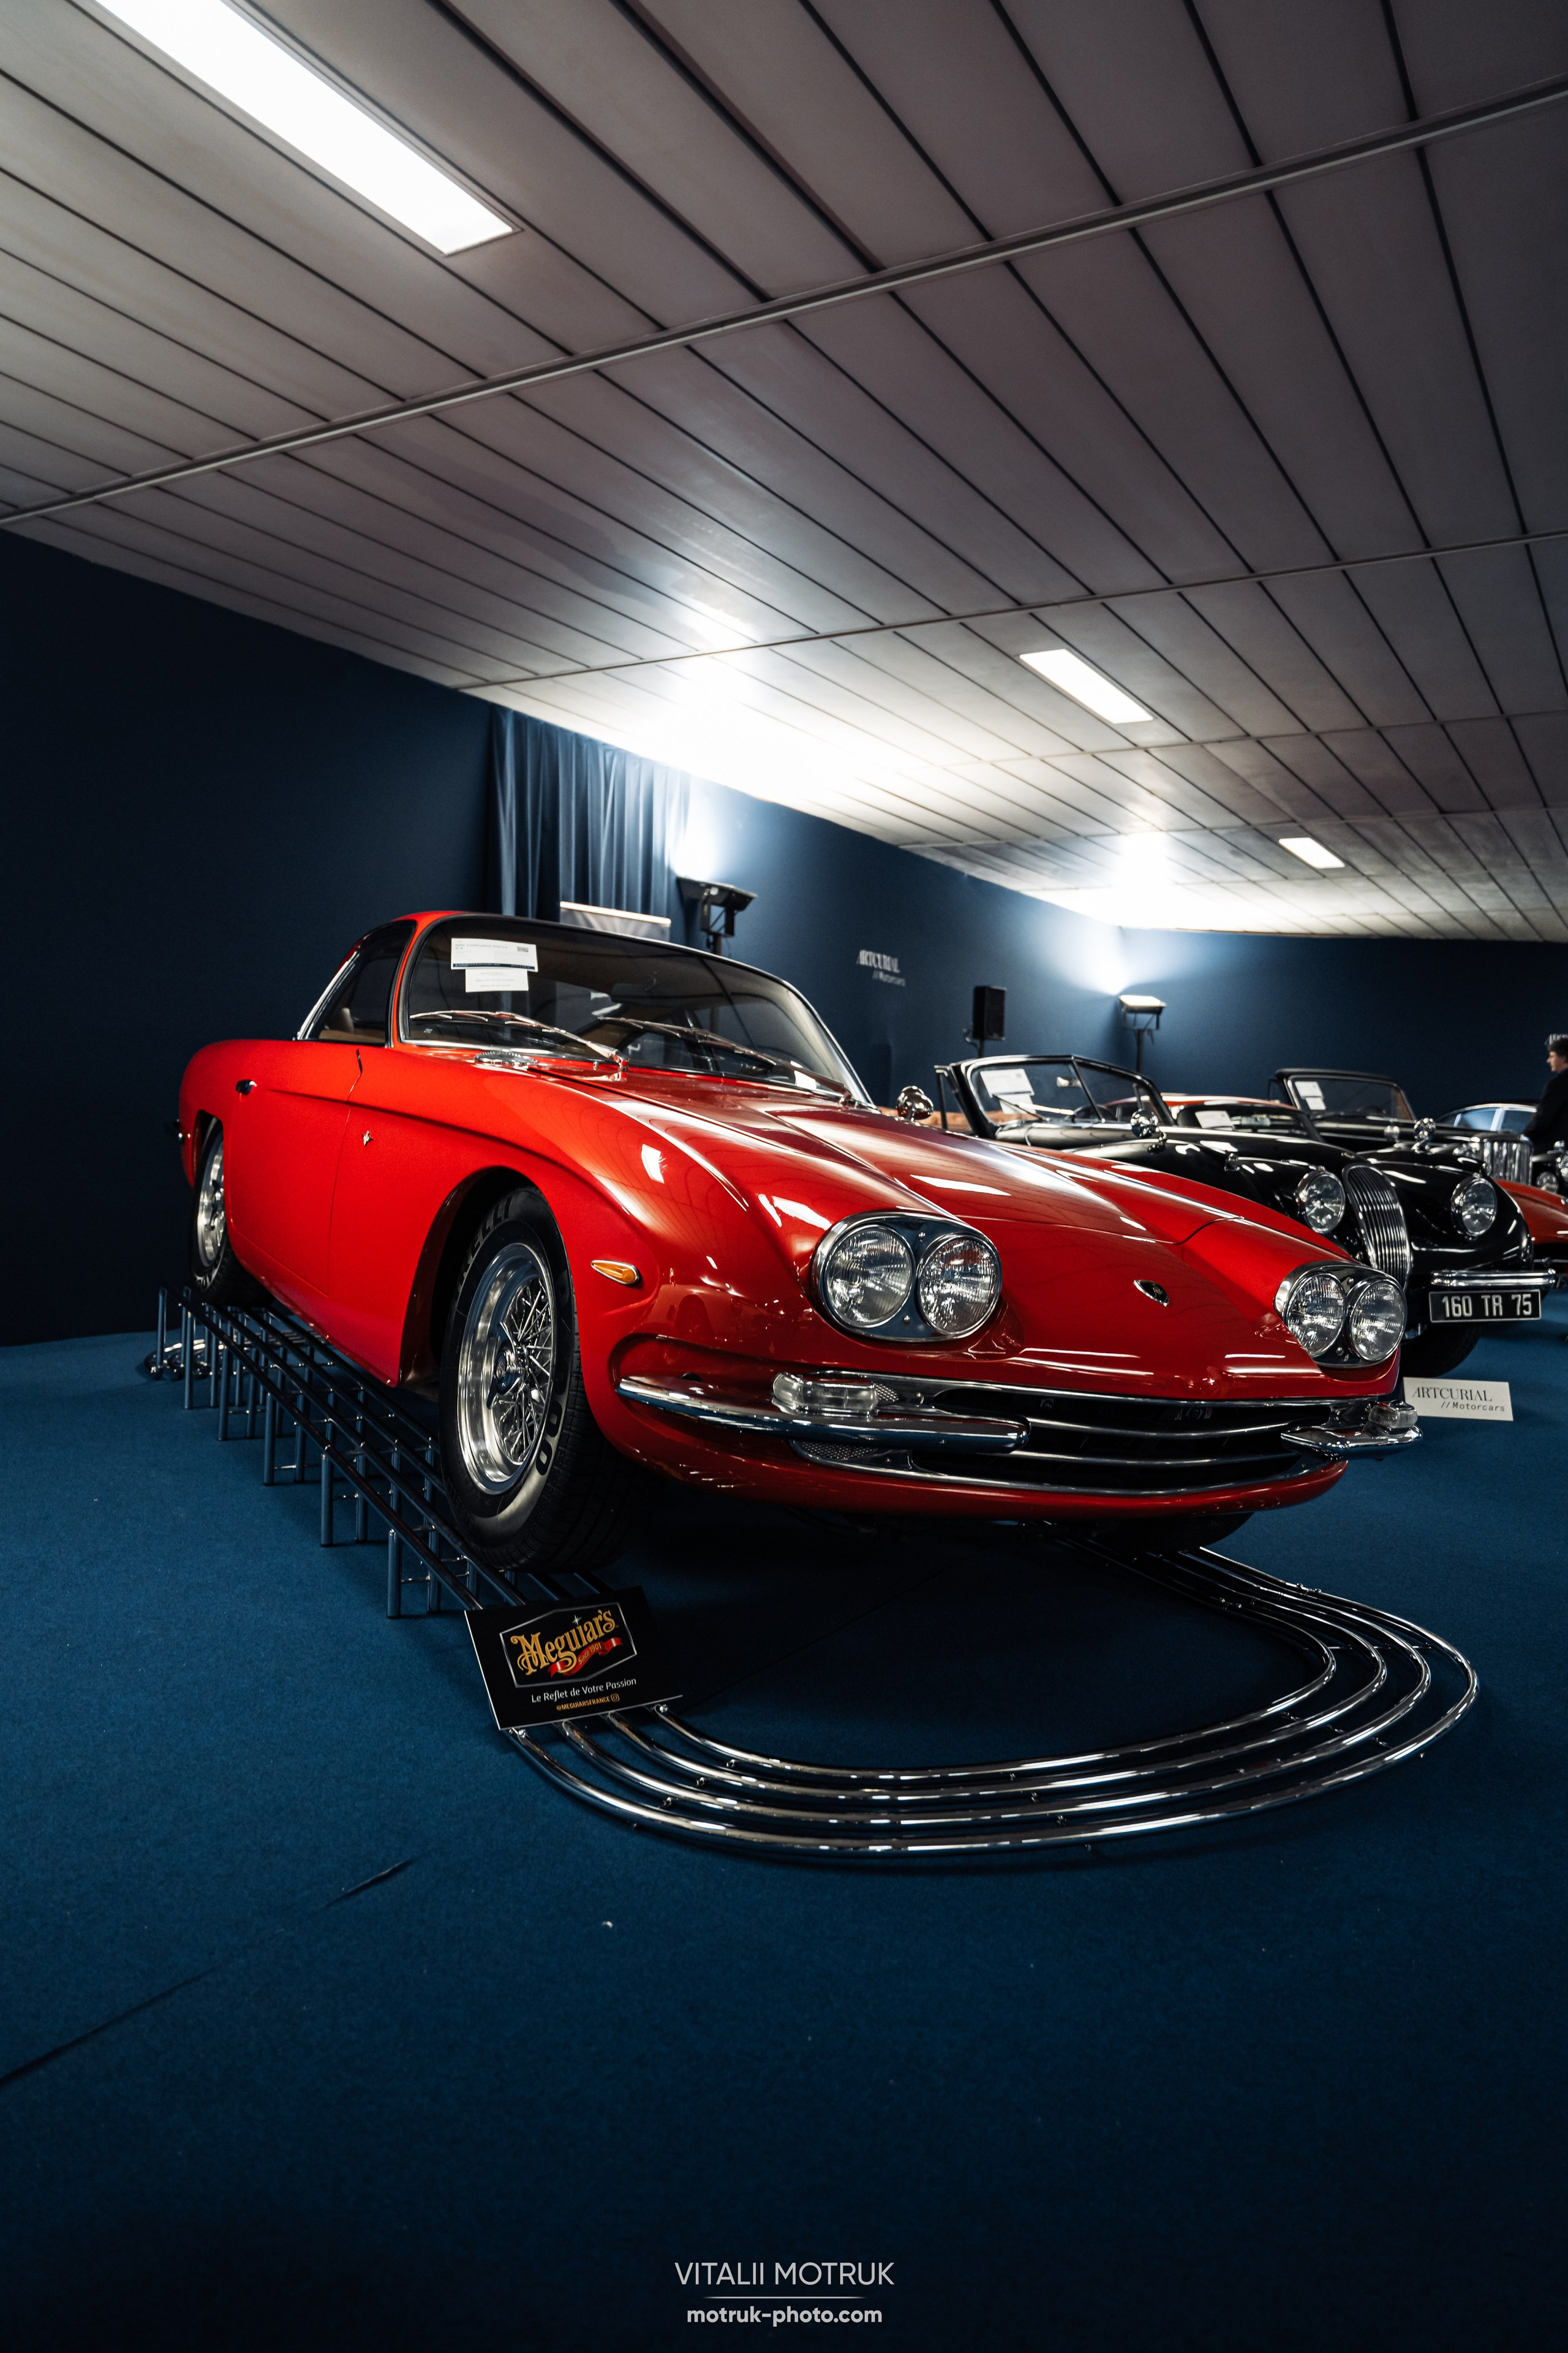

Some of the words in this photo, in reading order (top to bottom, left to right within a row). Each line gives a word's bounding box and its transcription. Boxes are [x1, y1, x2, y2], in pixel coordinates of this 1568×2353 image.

[1442, 1295, 1472, 1318] 160
[1481, 1294, 1503, 1317] TR
[1511, 1294, 1532, 1316] 75
[1412, 1386, 1493, 1402] ARTCURIAL
[510, 1609, 616, 1675] Meguiar's
[578, 1650, 590, 1666] Since
[589, 1642, 602, 1653] 1901
[531, 1694, 542, 1703] Le
[543, 1690, 568, 1702] Reflet
[570, 1687, 581, 1697] de
[582, 1685, 604, 1694] Votre
[606, 1678, 637, 1691] Passion
[556, 1696, 611, 1711] @MEGUIARSFRANCE
